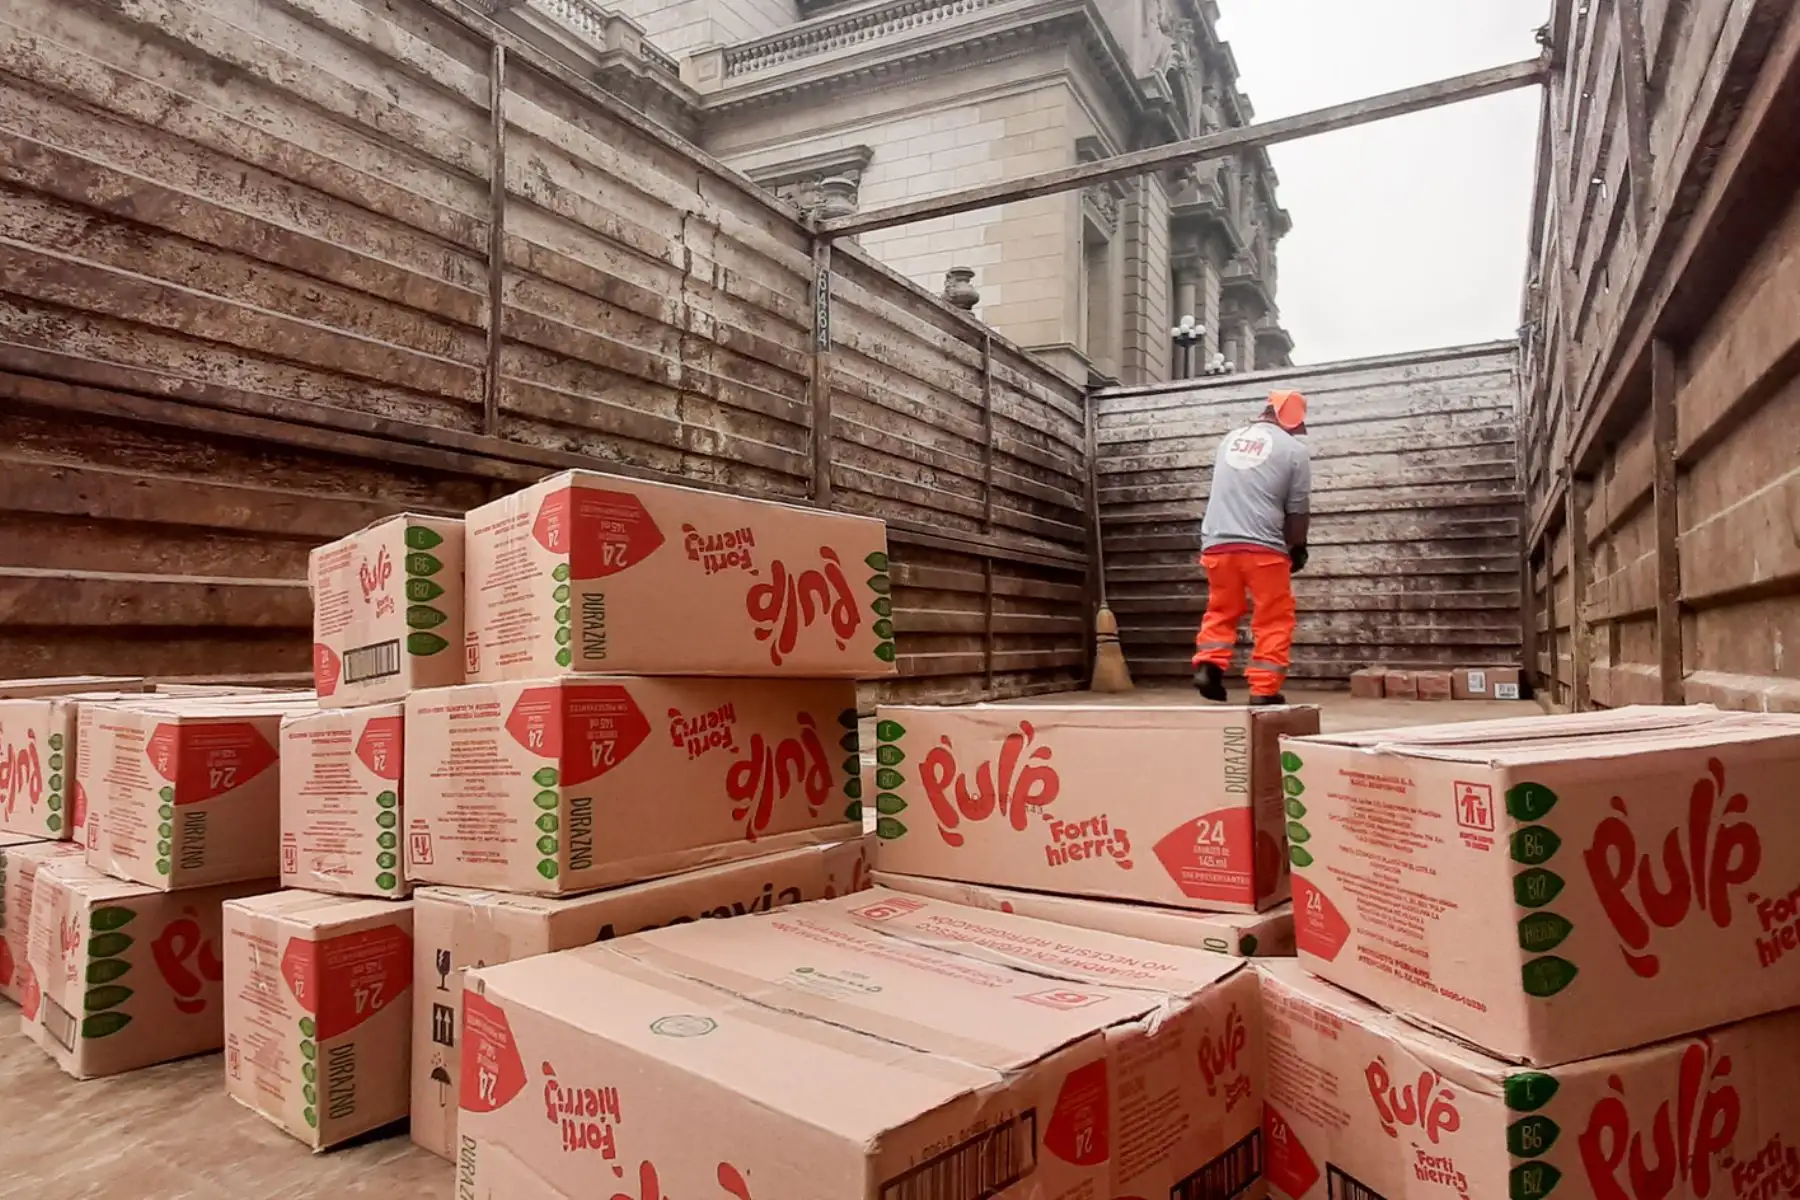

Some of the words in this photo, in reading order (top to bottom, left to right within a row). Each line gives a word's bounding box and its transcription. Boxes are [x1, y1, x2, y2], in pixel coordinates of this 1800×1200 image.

[548, 530, 559, 547] 24
[602, 542, 627, 567] 24
[414, 557, 430, 573] B6
[703, 549, 753, 575] Forti
[414, 582, 431, 598] B12
[746, 550, 861, 660] Pulp
[582, 592, 606, 660] DURAZNO
[528, 729, 544, 748] 24
[590, 740, 615, 768] 24
[685, 726, 734, 760] Forti
[373, 754, 387, 771] 24
[1224, 726, 1249, 793] DURAZNO
[209, 766, 237, 789] 24
[726, 720, 833, 834] Pulp
[919, 727, 1059, 840] Pulp
[180, 810, 207, 870] DURAZNO
[568, 796, 593, 870] DURAZNO
[1049, 813, 1108, 844] Forti
[1195, 819, 1225, 846] 24
[1523, 834, 1544, 857] B6
[1583, 770, 1762, 955] Pulp
[1305, 888, 1323, 913] 24
[1526, 874, 1547, 899] B12
[1757, 883, 1800, 932] For
[150, 916, 223, 1000] Pu
[1053, 943, 1140, 967] NECESITA
[1755, 917, 1800, 968] hie
[353, 981, 384, 1014] 24
[328, 1042, 357, 1121] DURAZNO
[478, 1066, 497, 1106] 24
[1365, 1060, 1461, 1145] Pulp
[1271, 1117, 1287, 1145] 24
[1521, 1125, 1542, 1150] B6
[1577, 1042, 1741, 1200] Pulp
[562, 1118, 616, 1161] Forti
[1076, 1126, 1093, 1159] 24
[457, 1135, 477, 1200] DURAZ
[1416, 1150, 1455, 1172] Forti
[1522, 1170, 1543, 1195] B12
